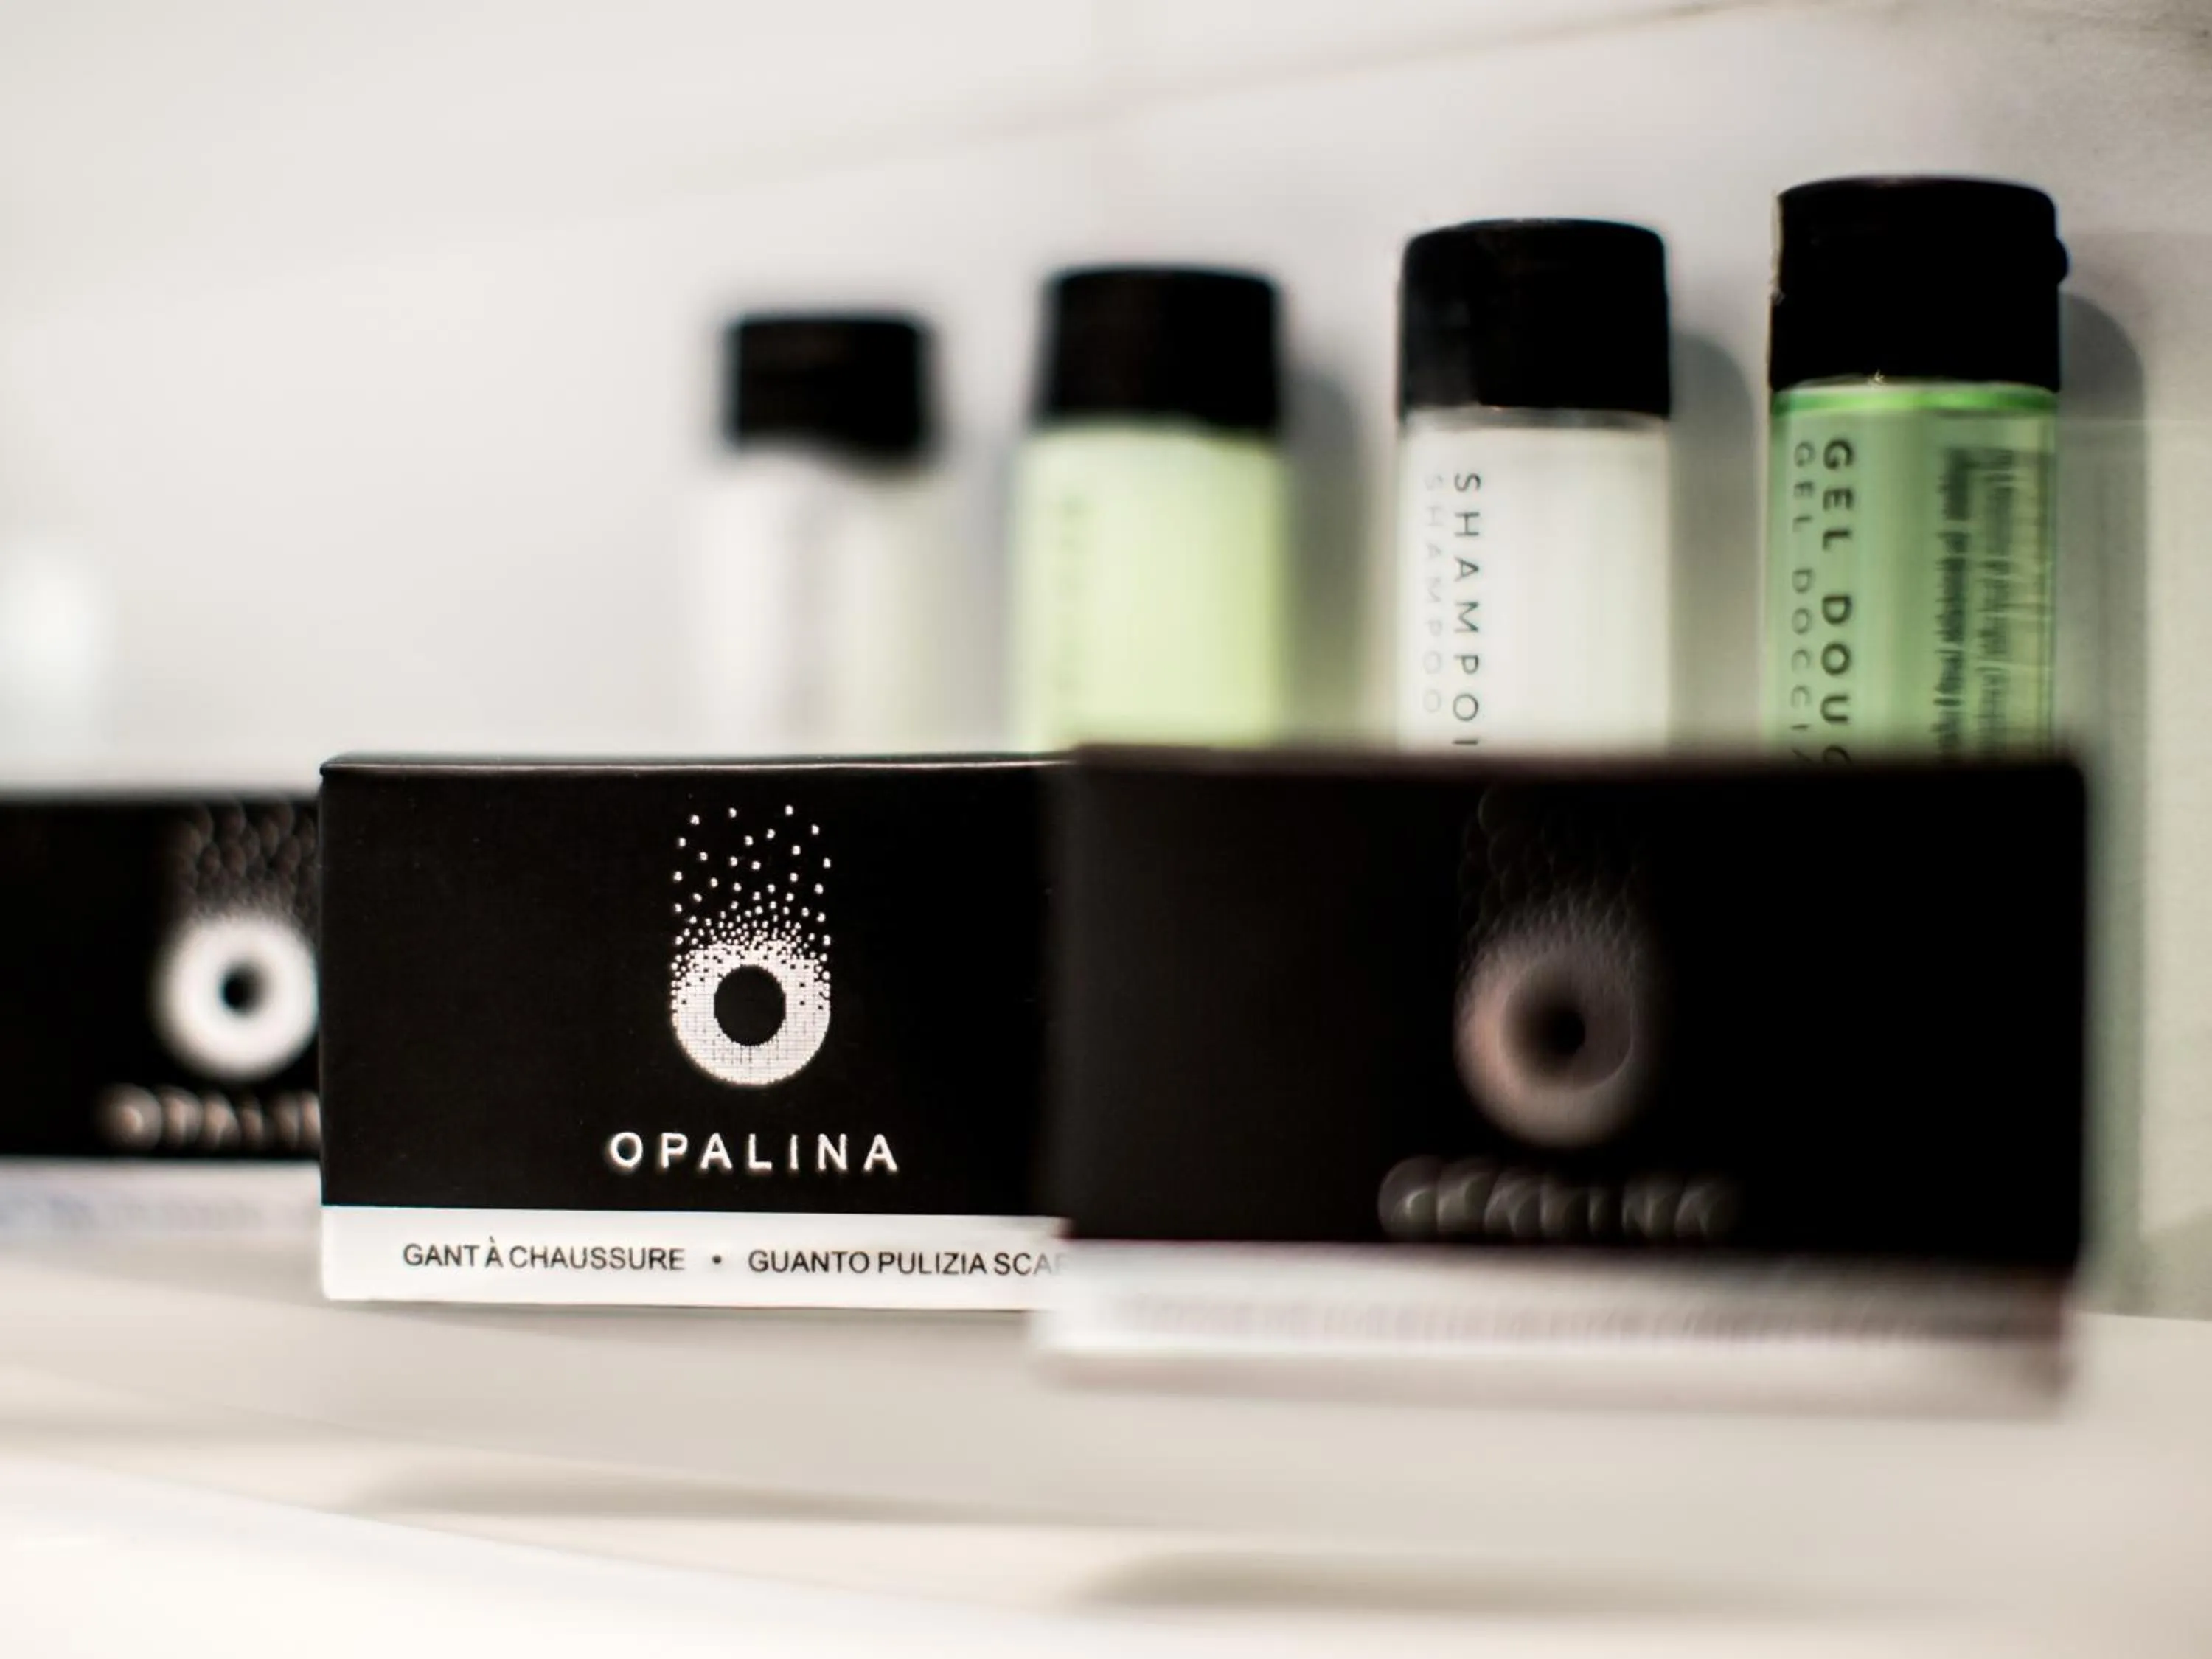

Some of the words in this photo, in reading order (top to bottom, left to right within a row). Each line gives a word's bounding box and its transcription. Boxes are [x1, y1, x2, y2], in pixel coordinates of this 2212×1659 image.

[1792, 442, 1816, 532] GEL
[1822, 438, 1855, 551] GEL
[608, 1131, 899, 1173] OPALINA
[403, 1243, 480, 1267] GANT
[485, 1236, 504, 1268] À
[509, 1245, 685, 1271] CHAUSSURE
[748, 1249, 871, 1274] GUANTO
[877, 1251, 987, 1276] PULIZIA
